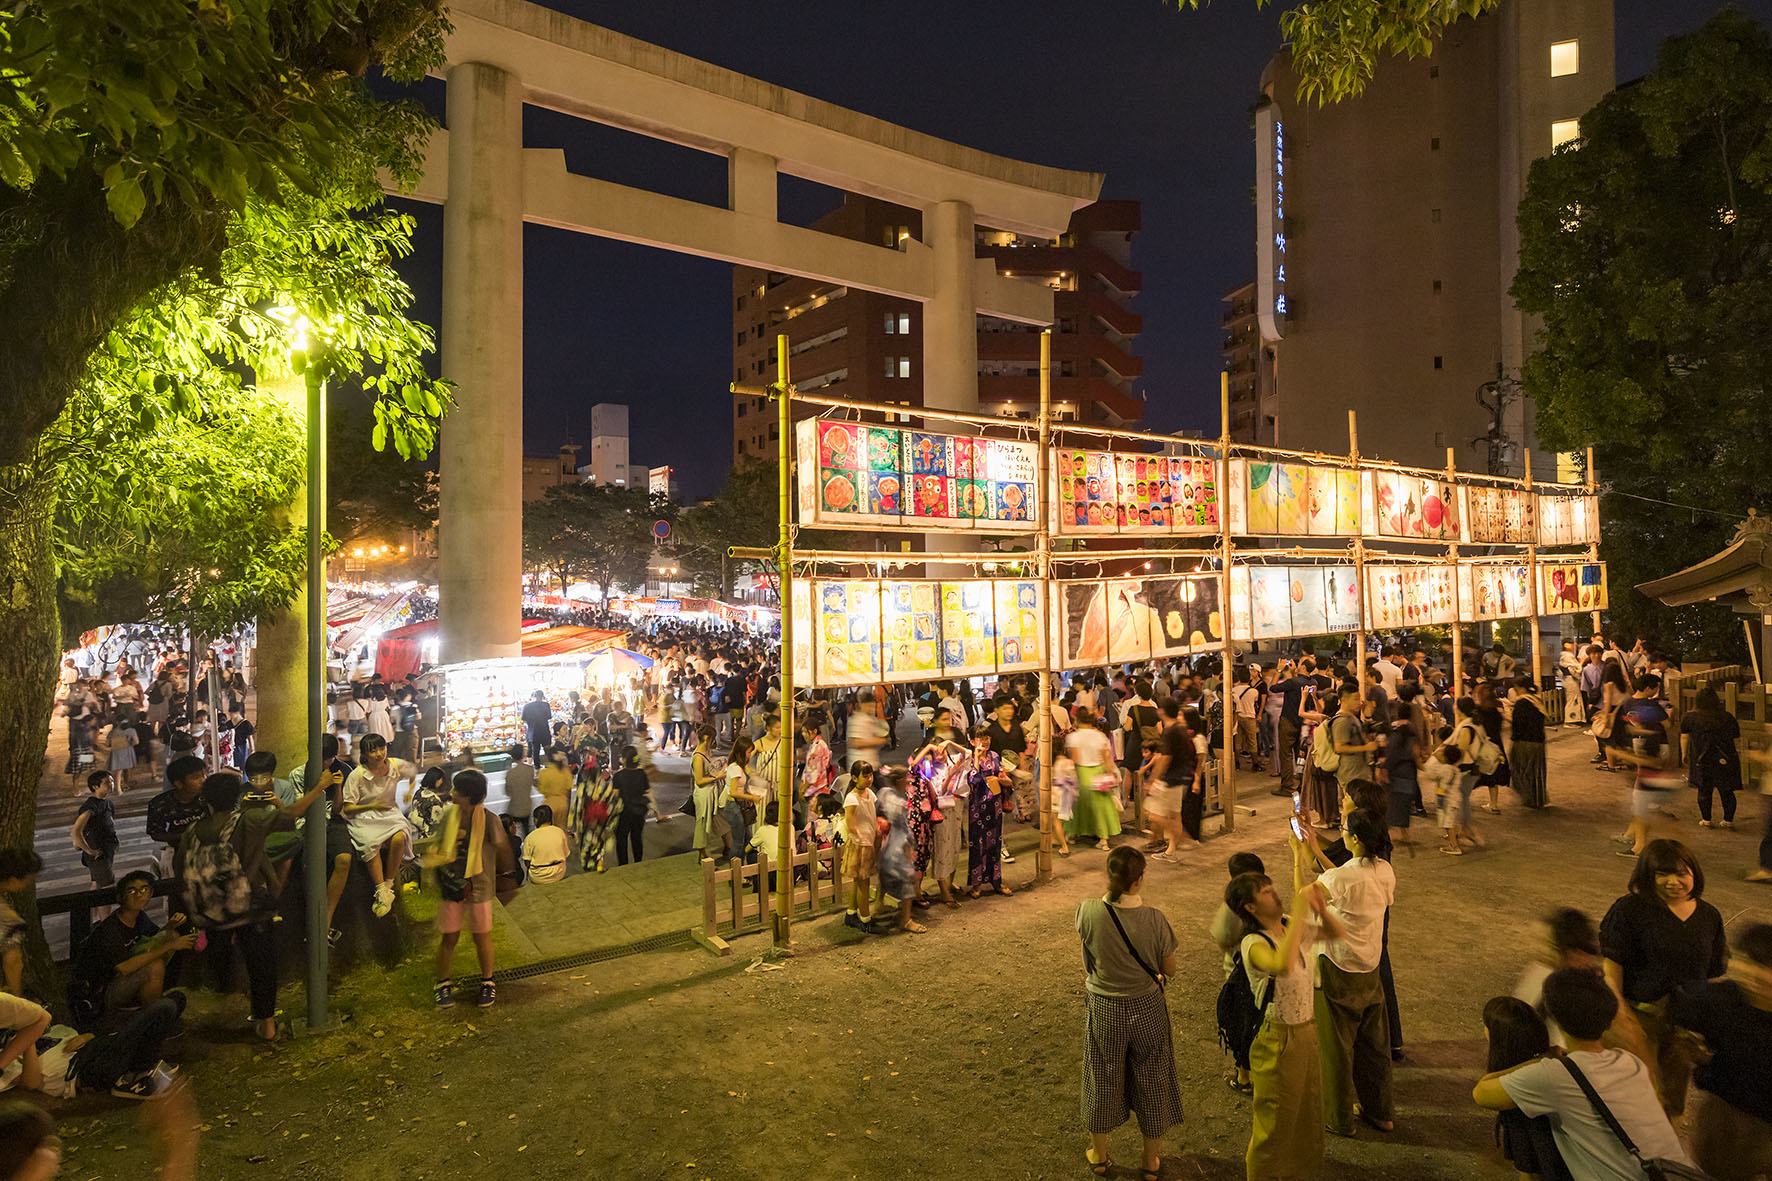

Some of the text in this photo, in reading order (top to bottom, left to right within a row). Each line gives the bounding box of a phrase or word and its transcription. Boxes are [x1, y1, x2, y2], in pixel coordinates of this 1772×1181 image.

[1275, 232, 1287, 314] 吹上荘
[997, 444, 1023, 453] ひらまつ
